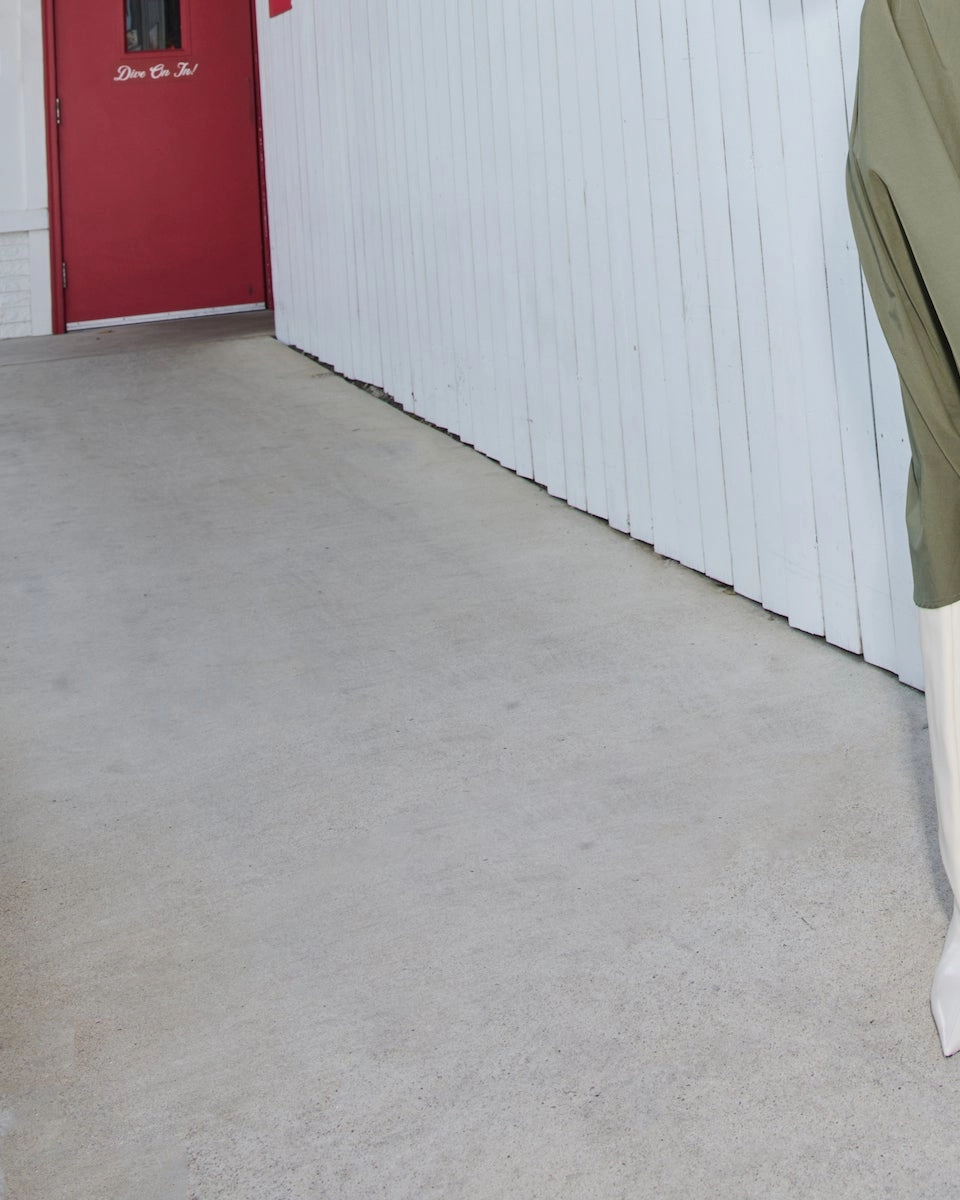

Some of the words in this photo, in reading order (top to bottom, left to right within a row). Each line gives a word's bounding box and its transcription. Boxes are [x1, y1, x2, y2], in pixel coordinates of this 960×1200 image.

[113, 64, 147, 82] Dive
[149, 63, 171, 80] On
[173, 61, 199, 78] In!
